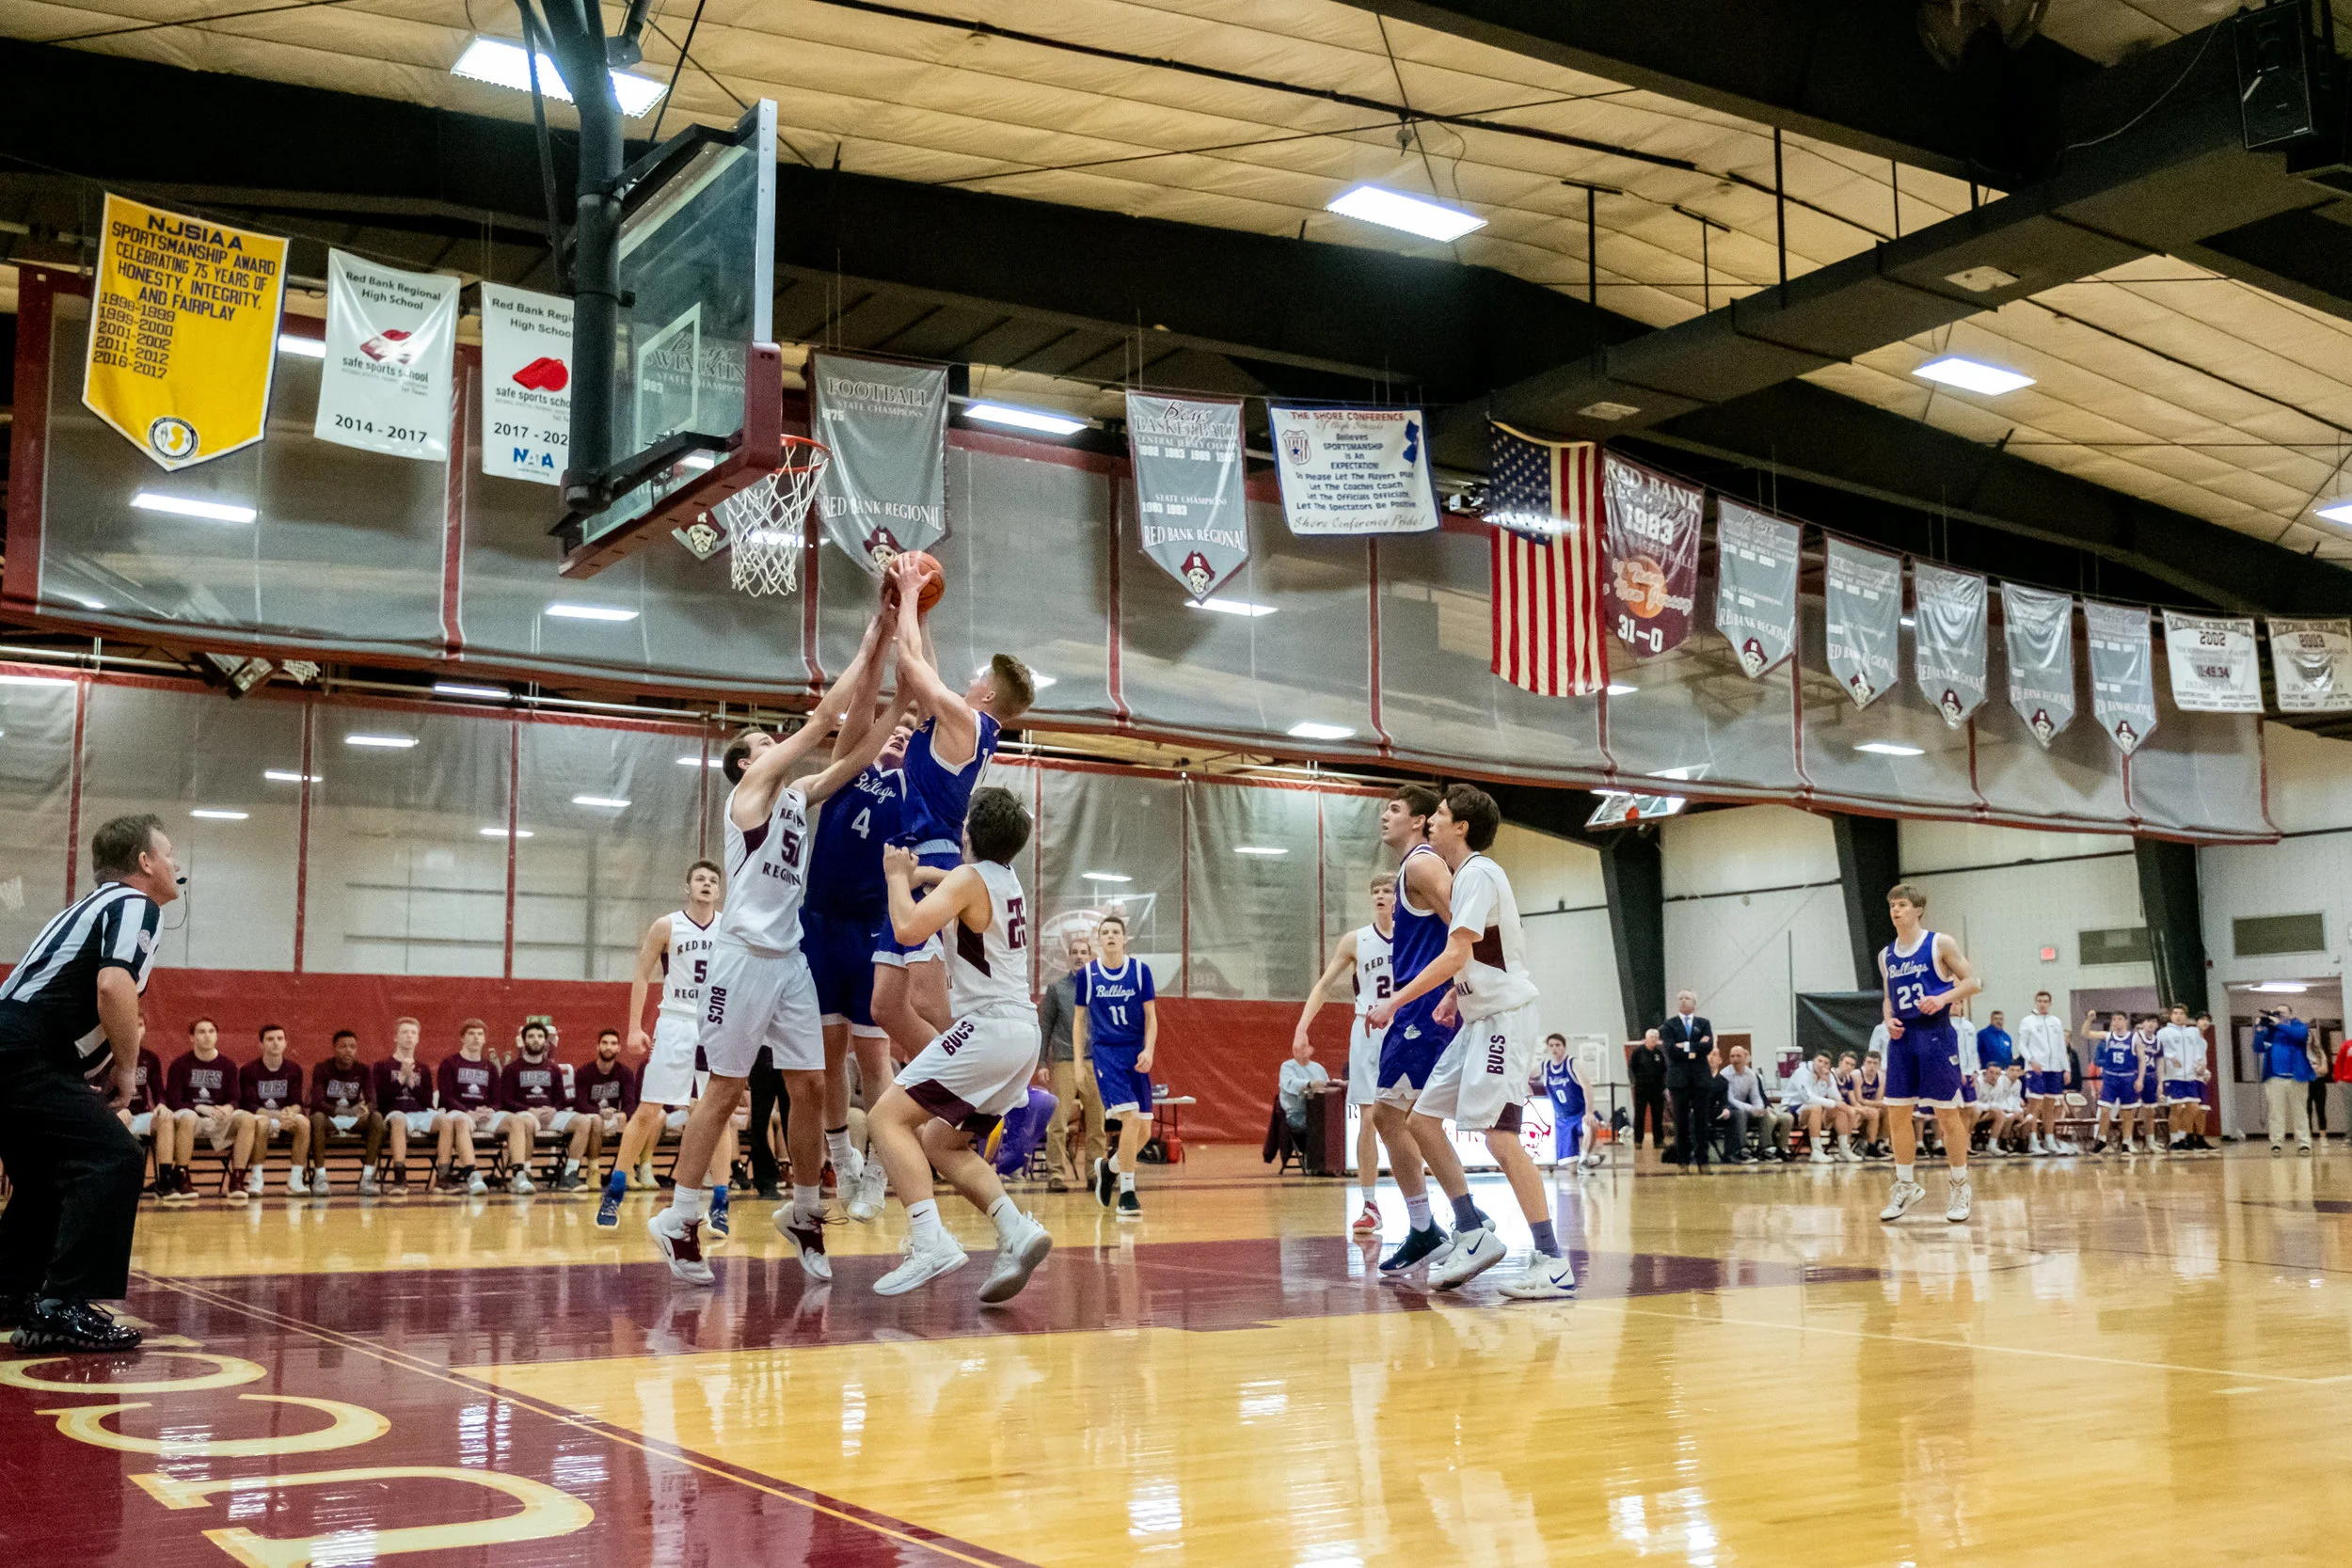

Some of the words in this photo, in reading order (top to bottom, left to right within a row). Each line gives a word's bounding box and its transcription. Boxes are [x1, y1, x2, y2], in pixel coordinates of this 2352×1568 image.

[149, 214, 243, 251] NJSIAA
[112, 221, 228, 263] SPORTSMANSHIP
[233, 255, 276, 276] AWARD
[117, 242, 189, 275] CELEBRATING
[195, 262, 208, 279] 75
[215, 266, 249, 288] YEARS
[253, 277, 267, 291] OF
[345, 272, 366, 284] Red
[369, 275, 395, 290] Bank
[397, 283, 441, 301] Regional
[361, 289, 388, 303] High
[389, 295, 424, 310] School
[139, 287, 167, 305] AND
[172, 293, 235, 321] FAIRPLAY
[492, 298, 514, 311] Red
[516, 303, 545, 318] Bank
[548, 309, 574, 324] Regi
[99, 321, 171, 351] 2001-2002
[510, 317, 536, 332] High
[538, 323, 571, 339] Schoo
[96, 336, 169, 365] 2011-2012
[93, 351, 167, 379] 2016-2017
[342, 356, 363, 369] safe
[365, 361, 396, 376] sports
[398, 368, 429, 383] shool
[496, 387, 516, 399] safe
[518, 391, 548, 404] sports
[549, 397, 571, 408] scho
[827, 377, 934, 407] FOOTBALL
[335, 413, 373, 434] 2014
[387, 425, 427, 443] 2017
[1135, 416, 1237, 440] BASKETBALL
[1290, 411, 1310, 420] THE
[1314, 412, 1343, 420] SHORE
[1347, 412, 1405, 421] CONFERENCE
[494, 422, 529, 438] 2017
[543, 430, 569, 447] 202
[1323, 442, 1384, 451] SPORTSMANSHIP
[1336, 433, 1369, 441] Believes
[1155, 494, 1178, 503] STATE
[1376, 482, 1404, 490] Coach
[1604, 458, 1643, 489] RED
[1649, 477, 1702, 514] BANK
[823, 495, 847, 519] RED
[851, 497, 882, 515] BANK
[885, 501, 944, 531] REGIONAL
[1625, 502, 1674, 545] 1983
[878, 531, 888, 544] R
[1144, 525, 1165, 547] RED
[1168, 527, 1194, 542] BANK
[1197, 529, 1247, 552] REGIONAL
[1193, 556, 1201, 567] R
[1618, 614, 1663, 653] 31-0
[2199, 630, 2226, 647] 2002
[851, 806, 870, 840] 4
[676, 940, 699, 956] RED
[1364, 957, 1384, 974] RED
[1888, 960, 1929, 978] Bulldogs
[707, 986, 727, 1025] BUCS
[1096, 984, 1136, 1002] Bulldogs
[1897, 982, 1925, 1010] 23
[1108, 1005, 1129, 1025] 11
[941, 1021, 975, 1057] BUCS
[1486, 1035, 1506, 1075] BUCS
[2112, 1052, 2125, 1064] 15
[1555, 1089, 1567, 1103] 0
